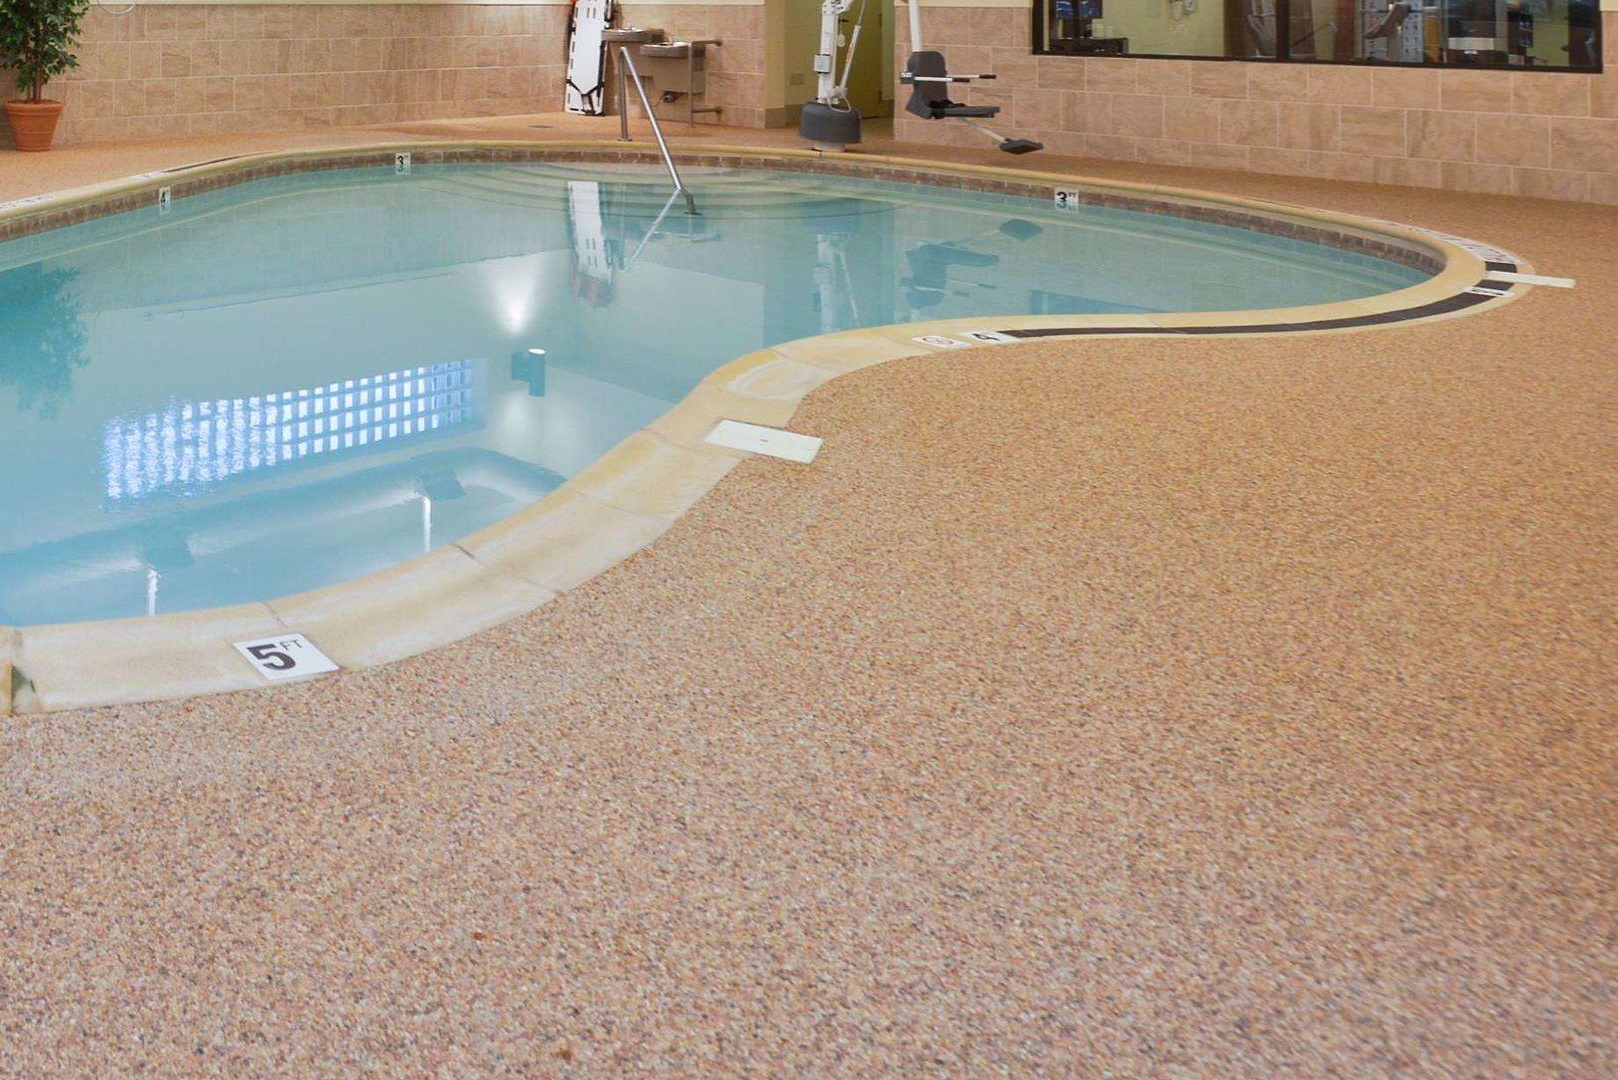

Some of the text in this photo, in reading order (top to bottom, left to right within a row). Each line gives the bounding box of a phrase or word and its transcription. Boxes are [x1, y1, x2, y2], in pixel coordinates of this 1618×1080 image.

[1057, 191, 1067, 202] 3
[247, 639, 303, 671] 5 FT
